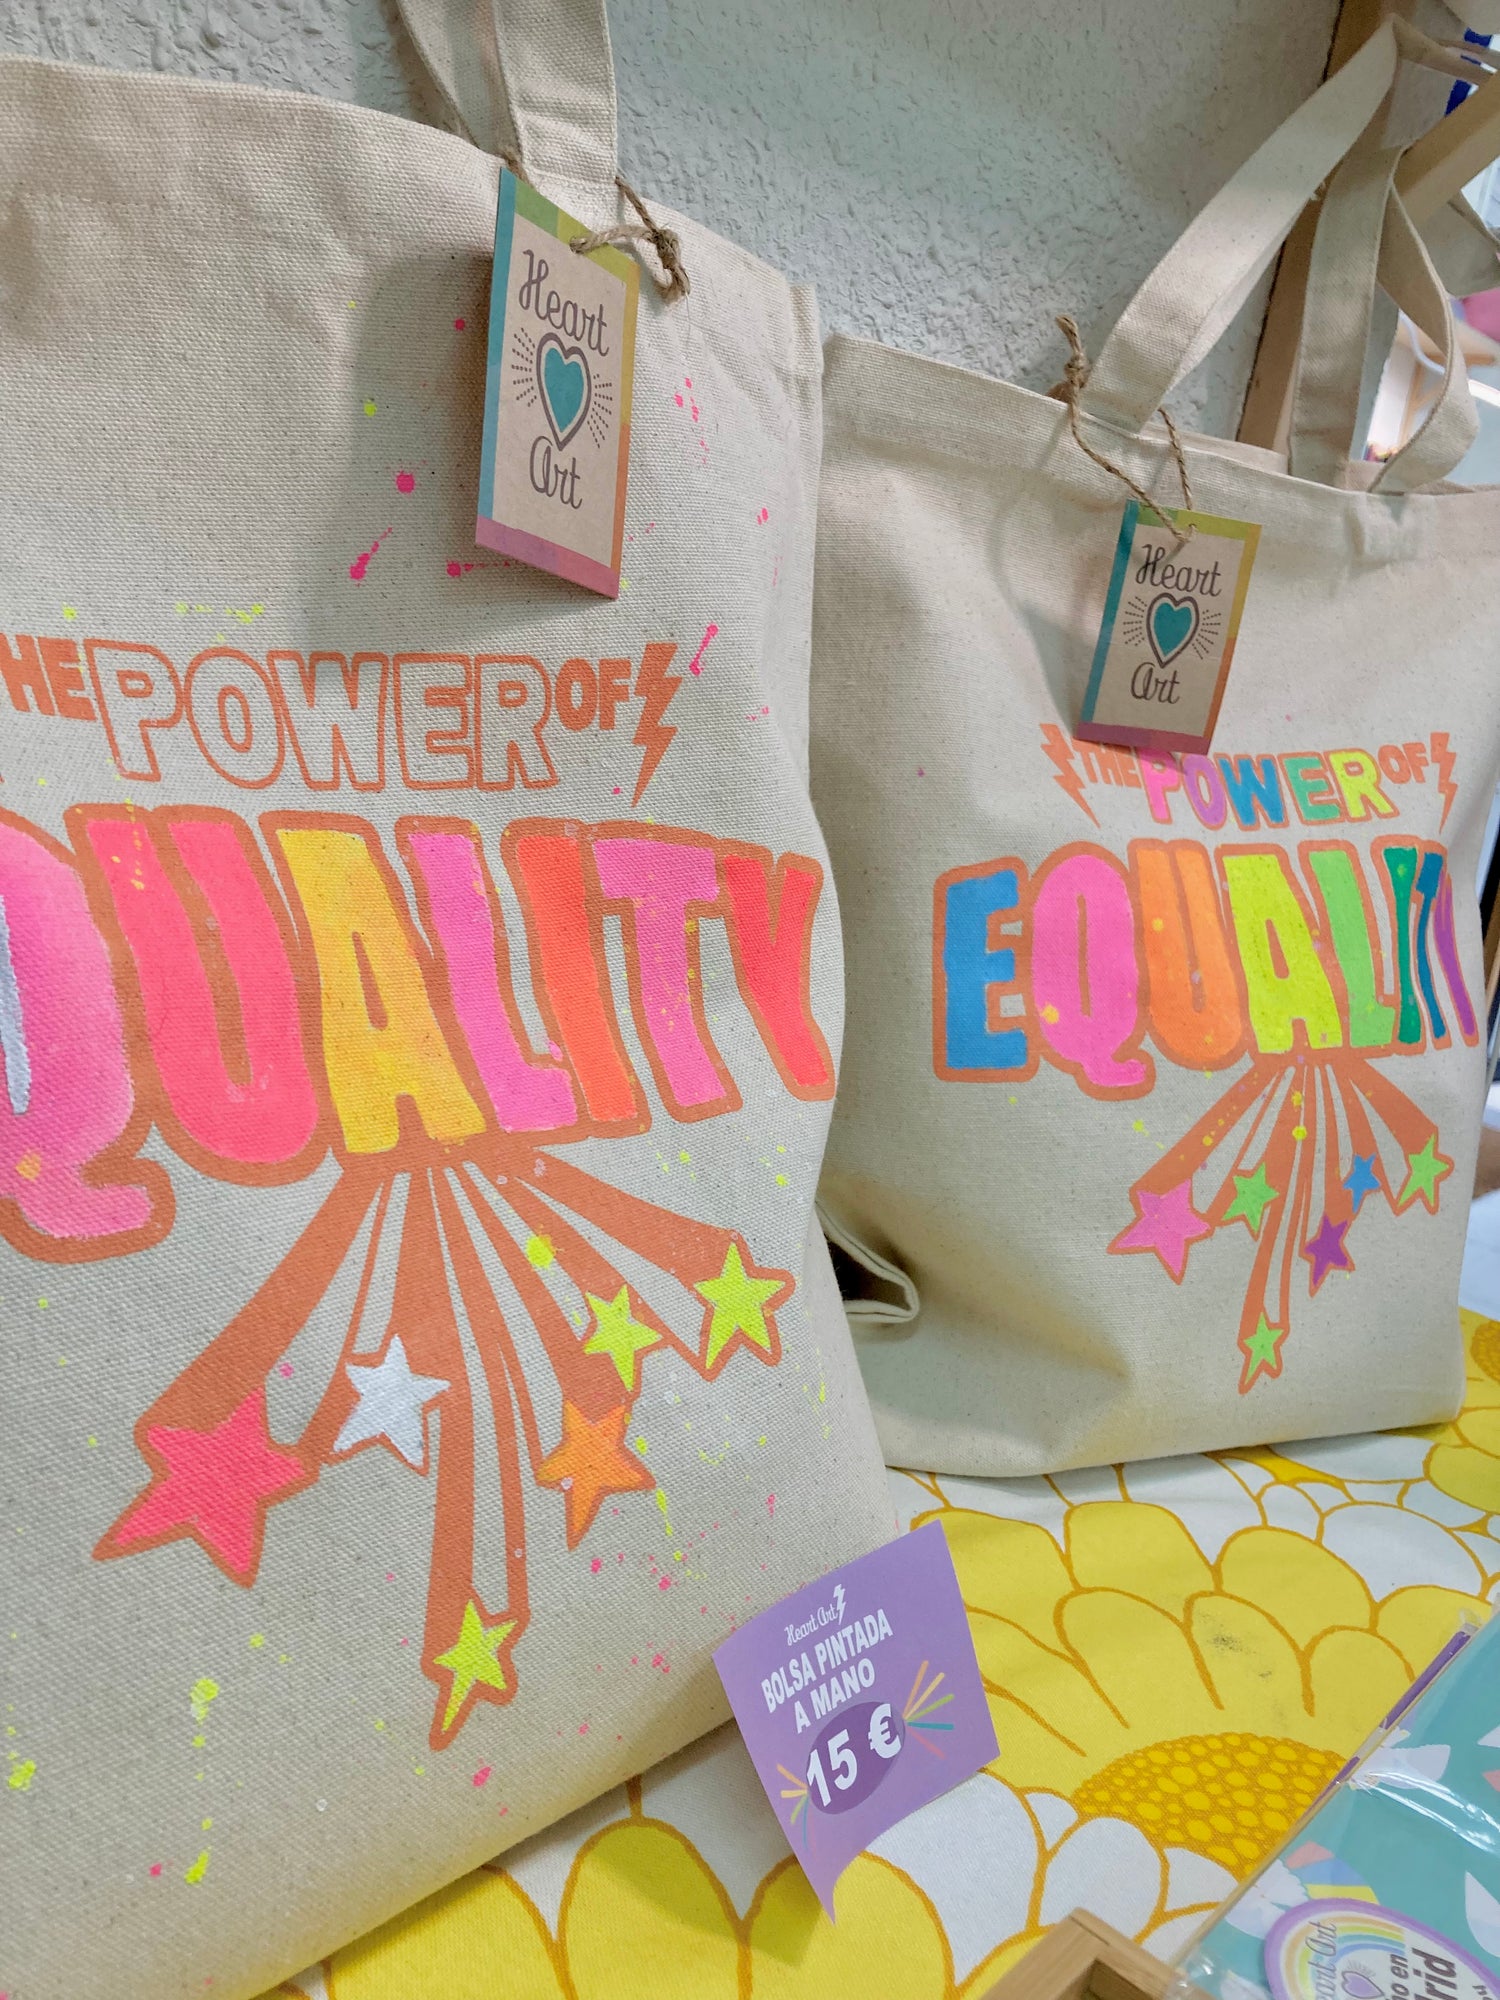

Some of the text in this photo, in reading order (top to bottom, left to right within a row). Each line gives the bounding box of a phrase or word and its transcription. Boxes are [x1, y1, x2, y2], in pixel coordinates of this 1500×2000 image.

[518, 249, 610, 357] Heart
[529, 435, 582, 510] Art
[1135, 543, 1222, 597] Heart
[83, 638, 559, 792] POWER
[555, 656, 634, 731] OF
[1130, 661, 1180, 704] Art
[1071, 737, 1432, 832] THE POWER OF
[933, 835, 1480, 1101] EQUALITY
[761, 1608, 894, 1713] BOLSA PINTADA
[784, 1604, 839, 1646] Heart Art
[794, 1658, 876, 1734] A MANO
[806, 1703, 902, 1807] 15 €
[1305, 1921, 1337, 1956] Art
[1390, 1954, 1409, 1979] en
